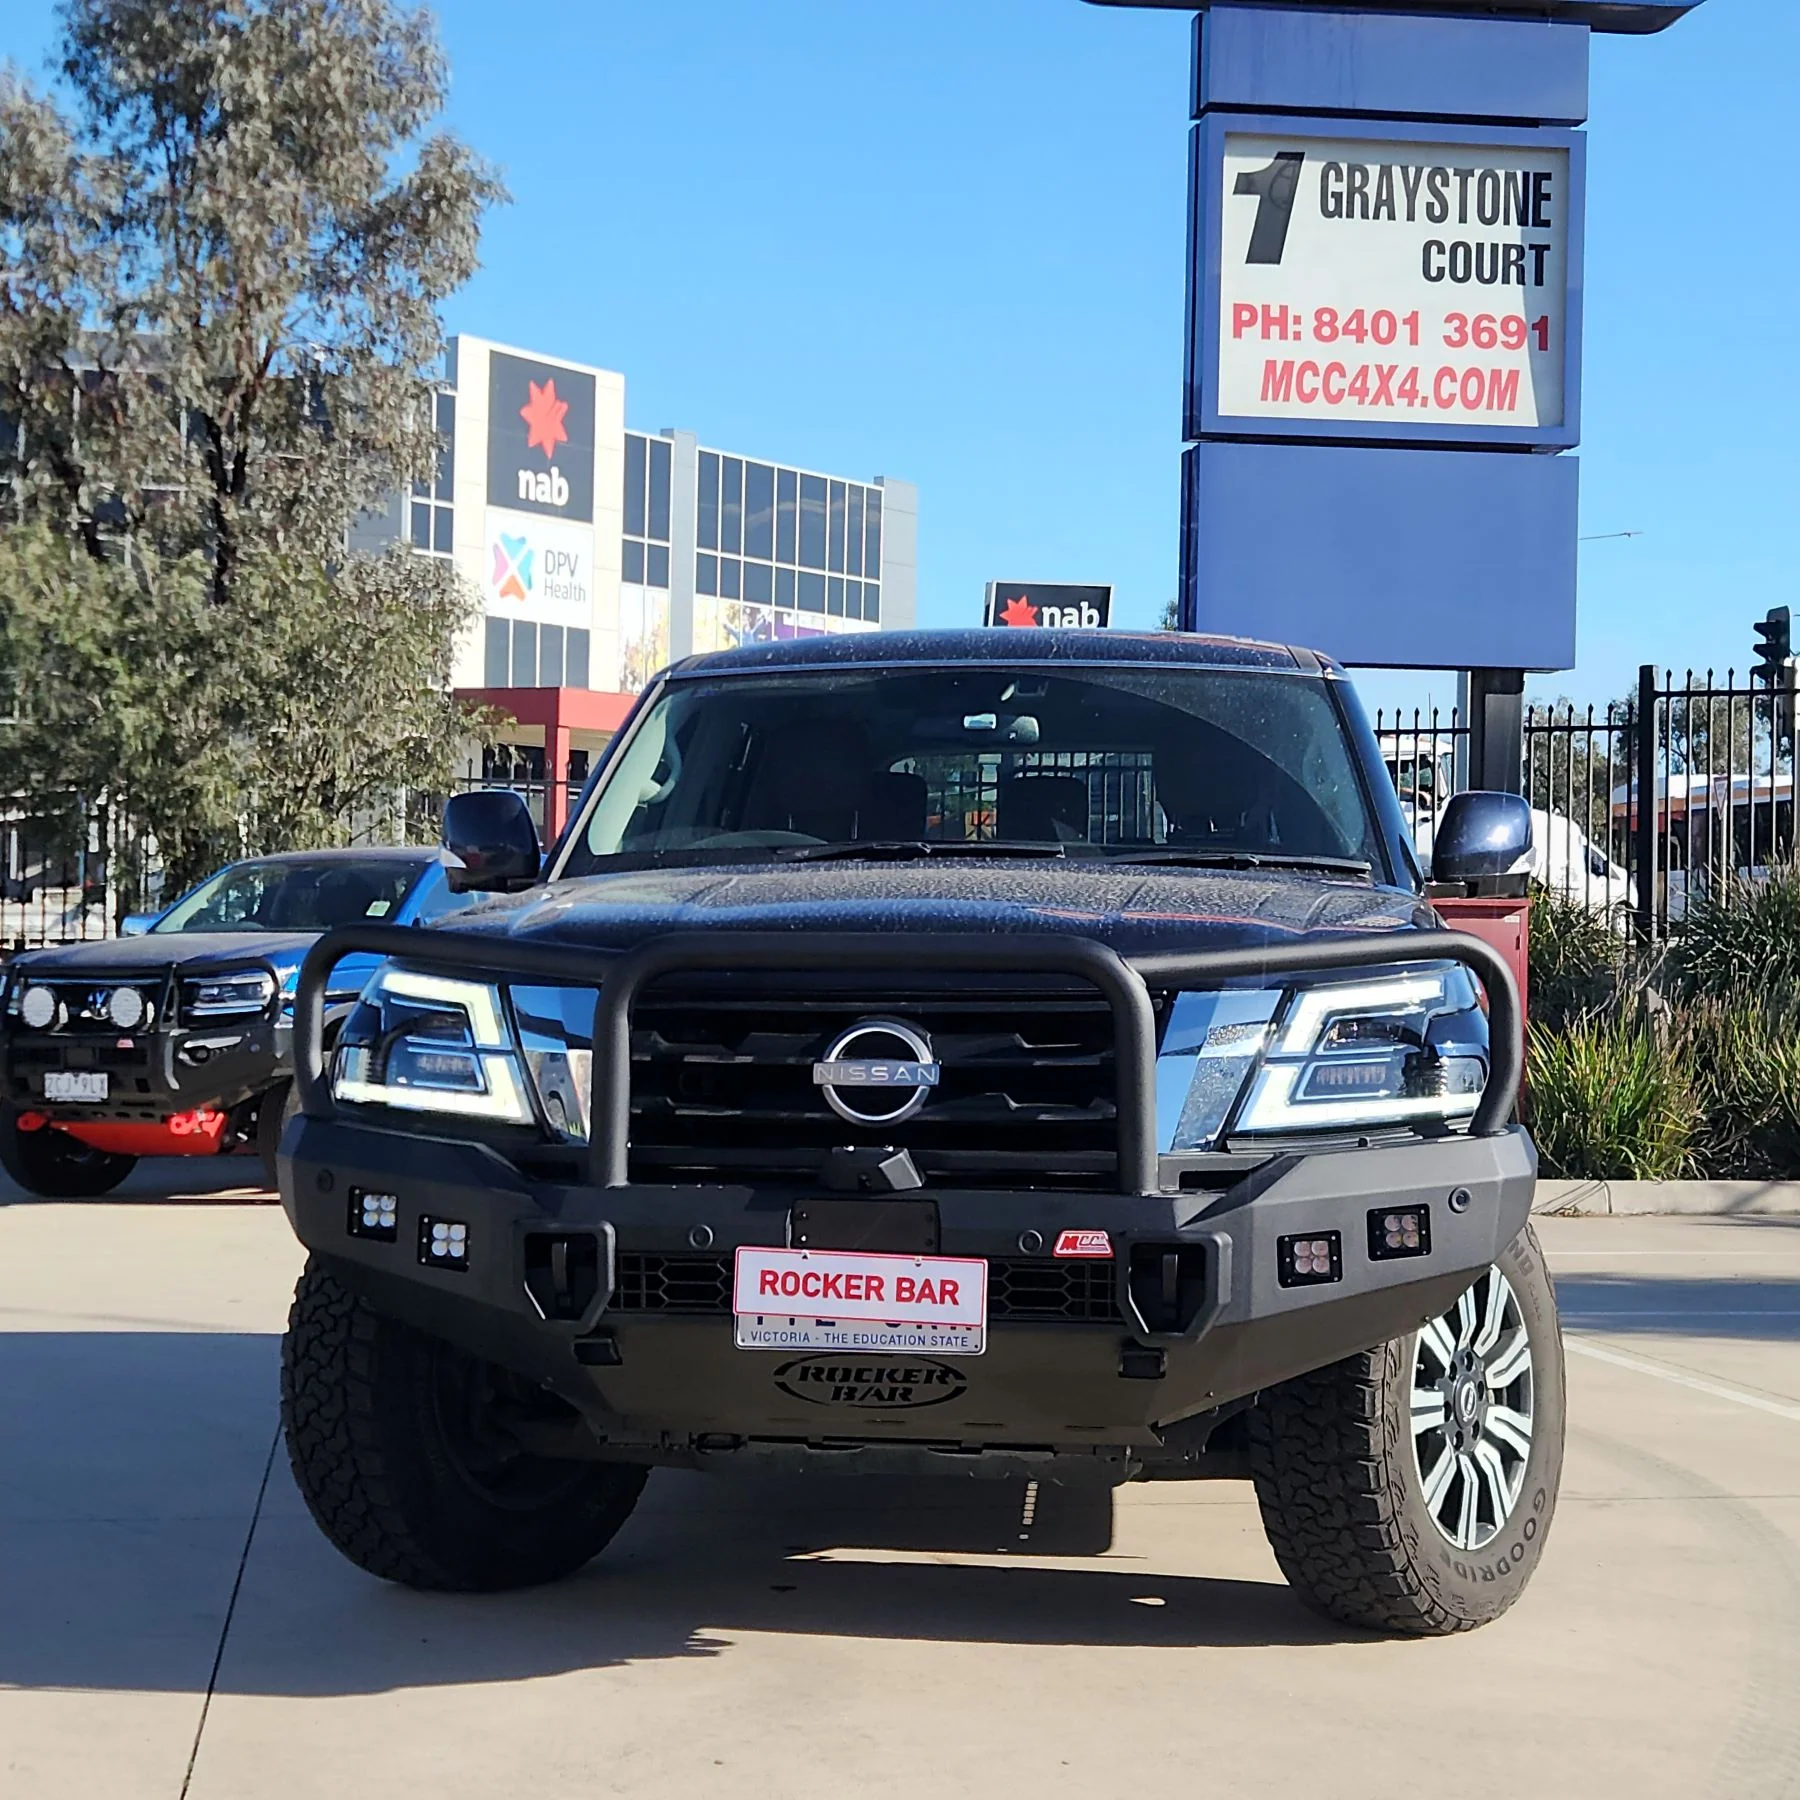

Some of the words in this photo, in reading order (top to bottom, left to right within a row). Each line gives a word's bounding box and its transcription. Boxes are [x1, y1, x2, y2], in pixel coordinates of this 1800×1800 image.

[1232, 151, 1305, 265] 1
[1319, 161, 1553, 228] GRAYSTONE
[1422, 239, 1551, 287] COURT
[1232, 302, 1302, 341] PH:
[1312, 306, 1420, 346] 8401
[1442, 312, 1549, 352] 3691
[1259, 359, 1521, 412] MCC4X4.COM
[517, 466, 569, 506] nab
[544, 550, 579, 578] DPV
[543, 577, 586, 603] Health
[1041, 600, 1100, 628] nab
[817, 1065, 936, 1082] NISSAN
[759, 1269, 885, 1301] ROCKER
[895, 1276, 960, 1306] BAR
[750, 1331, 811, 1344] VICTORIA
[824, 1333, 848, 1344] THE
[852, 1334, 926, 1346] EDUCATION
[930, 1335, 969, 1347] STATE
[799, 1365, 951, 1385] ROCKER
[830, 1385, 913, 1402] BAR
